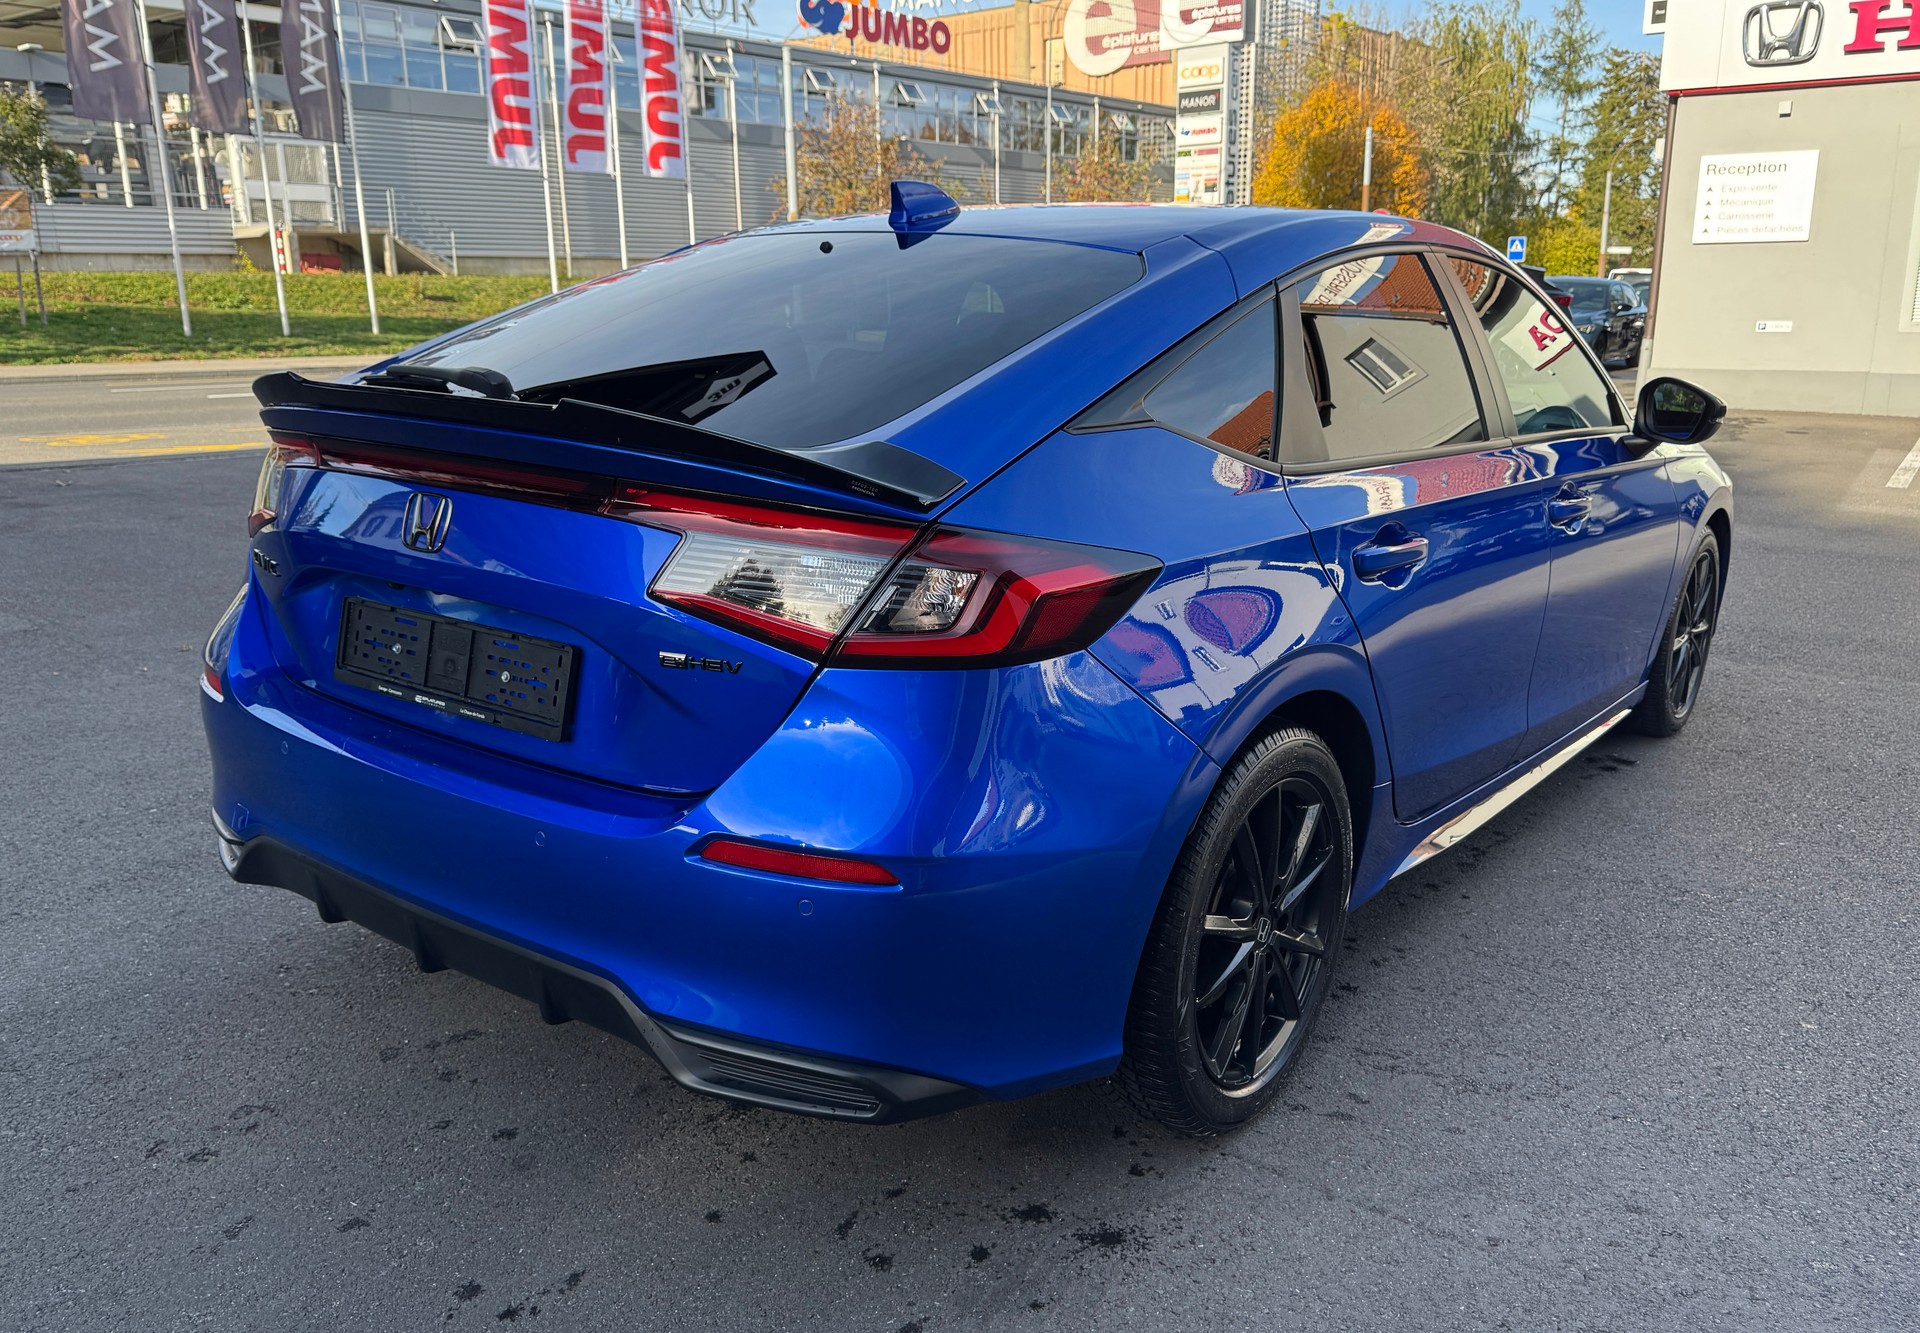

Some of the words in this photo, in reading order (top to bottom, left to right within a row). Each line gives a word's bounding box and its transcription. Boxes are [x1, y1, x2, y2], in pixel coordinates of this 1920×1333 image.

[1192, 4, 1242, 20] éplatures
[1215, 14, 1242, 25] centre
[846, 4, 950, 54] JUMBO
[1102, 31, 1160, 49] éplature
[1181, 64, 1219, 80] coop
[1181, 94, 1217, 109] MANOR
[1706, 161, 1787, 176] Réception
[1721, 184, 1777, 193] Expo-vente
[1718, 211, 1774, 220] Carrosserie
